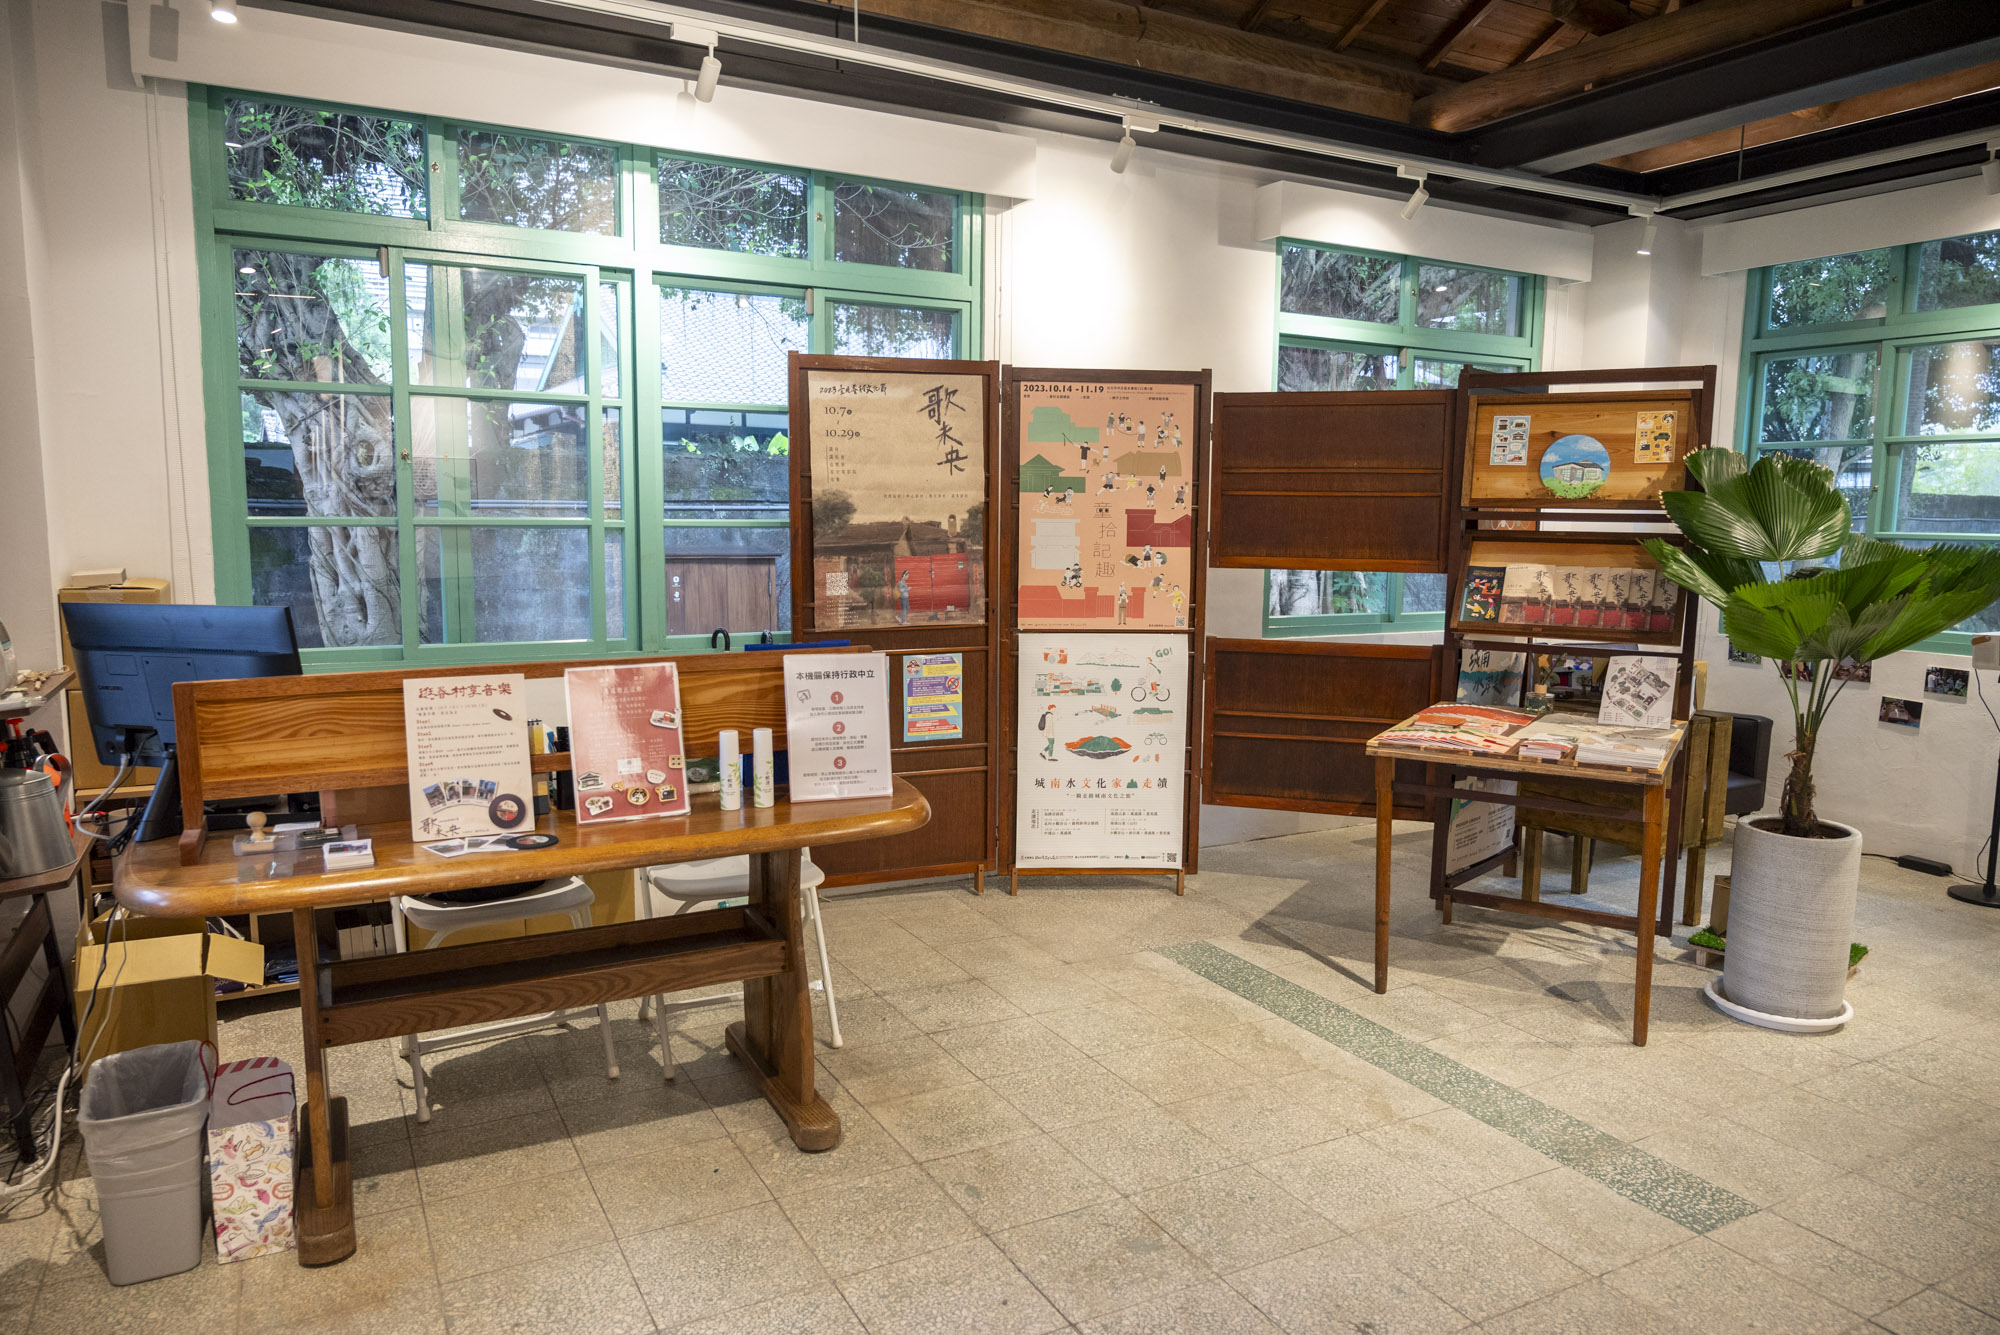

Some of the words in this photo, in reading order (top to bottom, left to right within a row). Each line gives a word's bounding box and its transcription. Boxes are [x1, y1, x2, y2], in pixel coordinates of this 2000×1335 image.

[1023, 384, 1073, 393] 2023.10.14
[916, 384, 969, 477] 歌未央
[1092, 501, 1118, 578] 童拾記趣
[1155, 647, 1173, 658] GO!
[796, 669, 875, 681] 本機關保持行政中立
